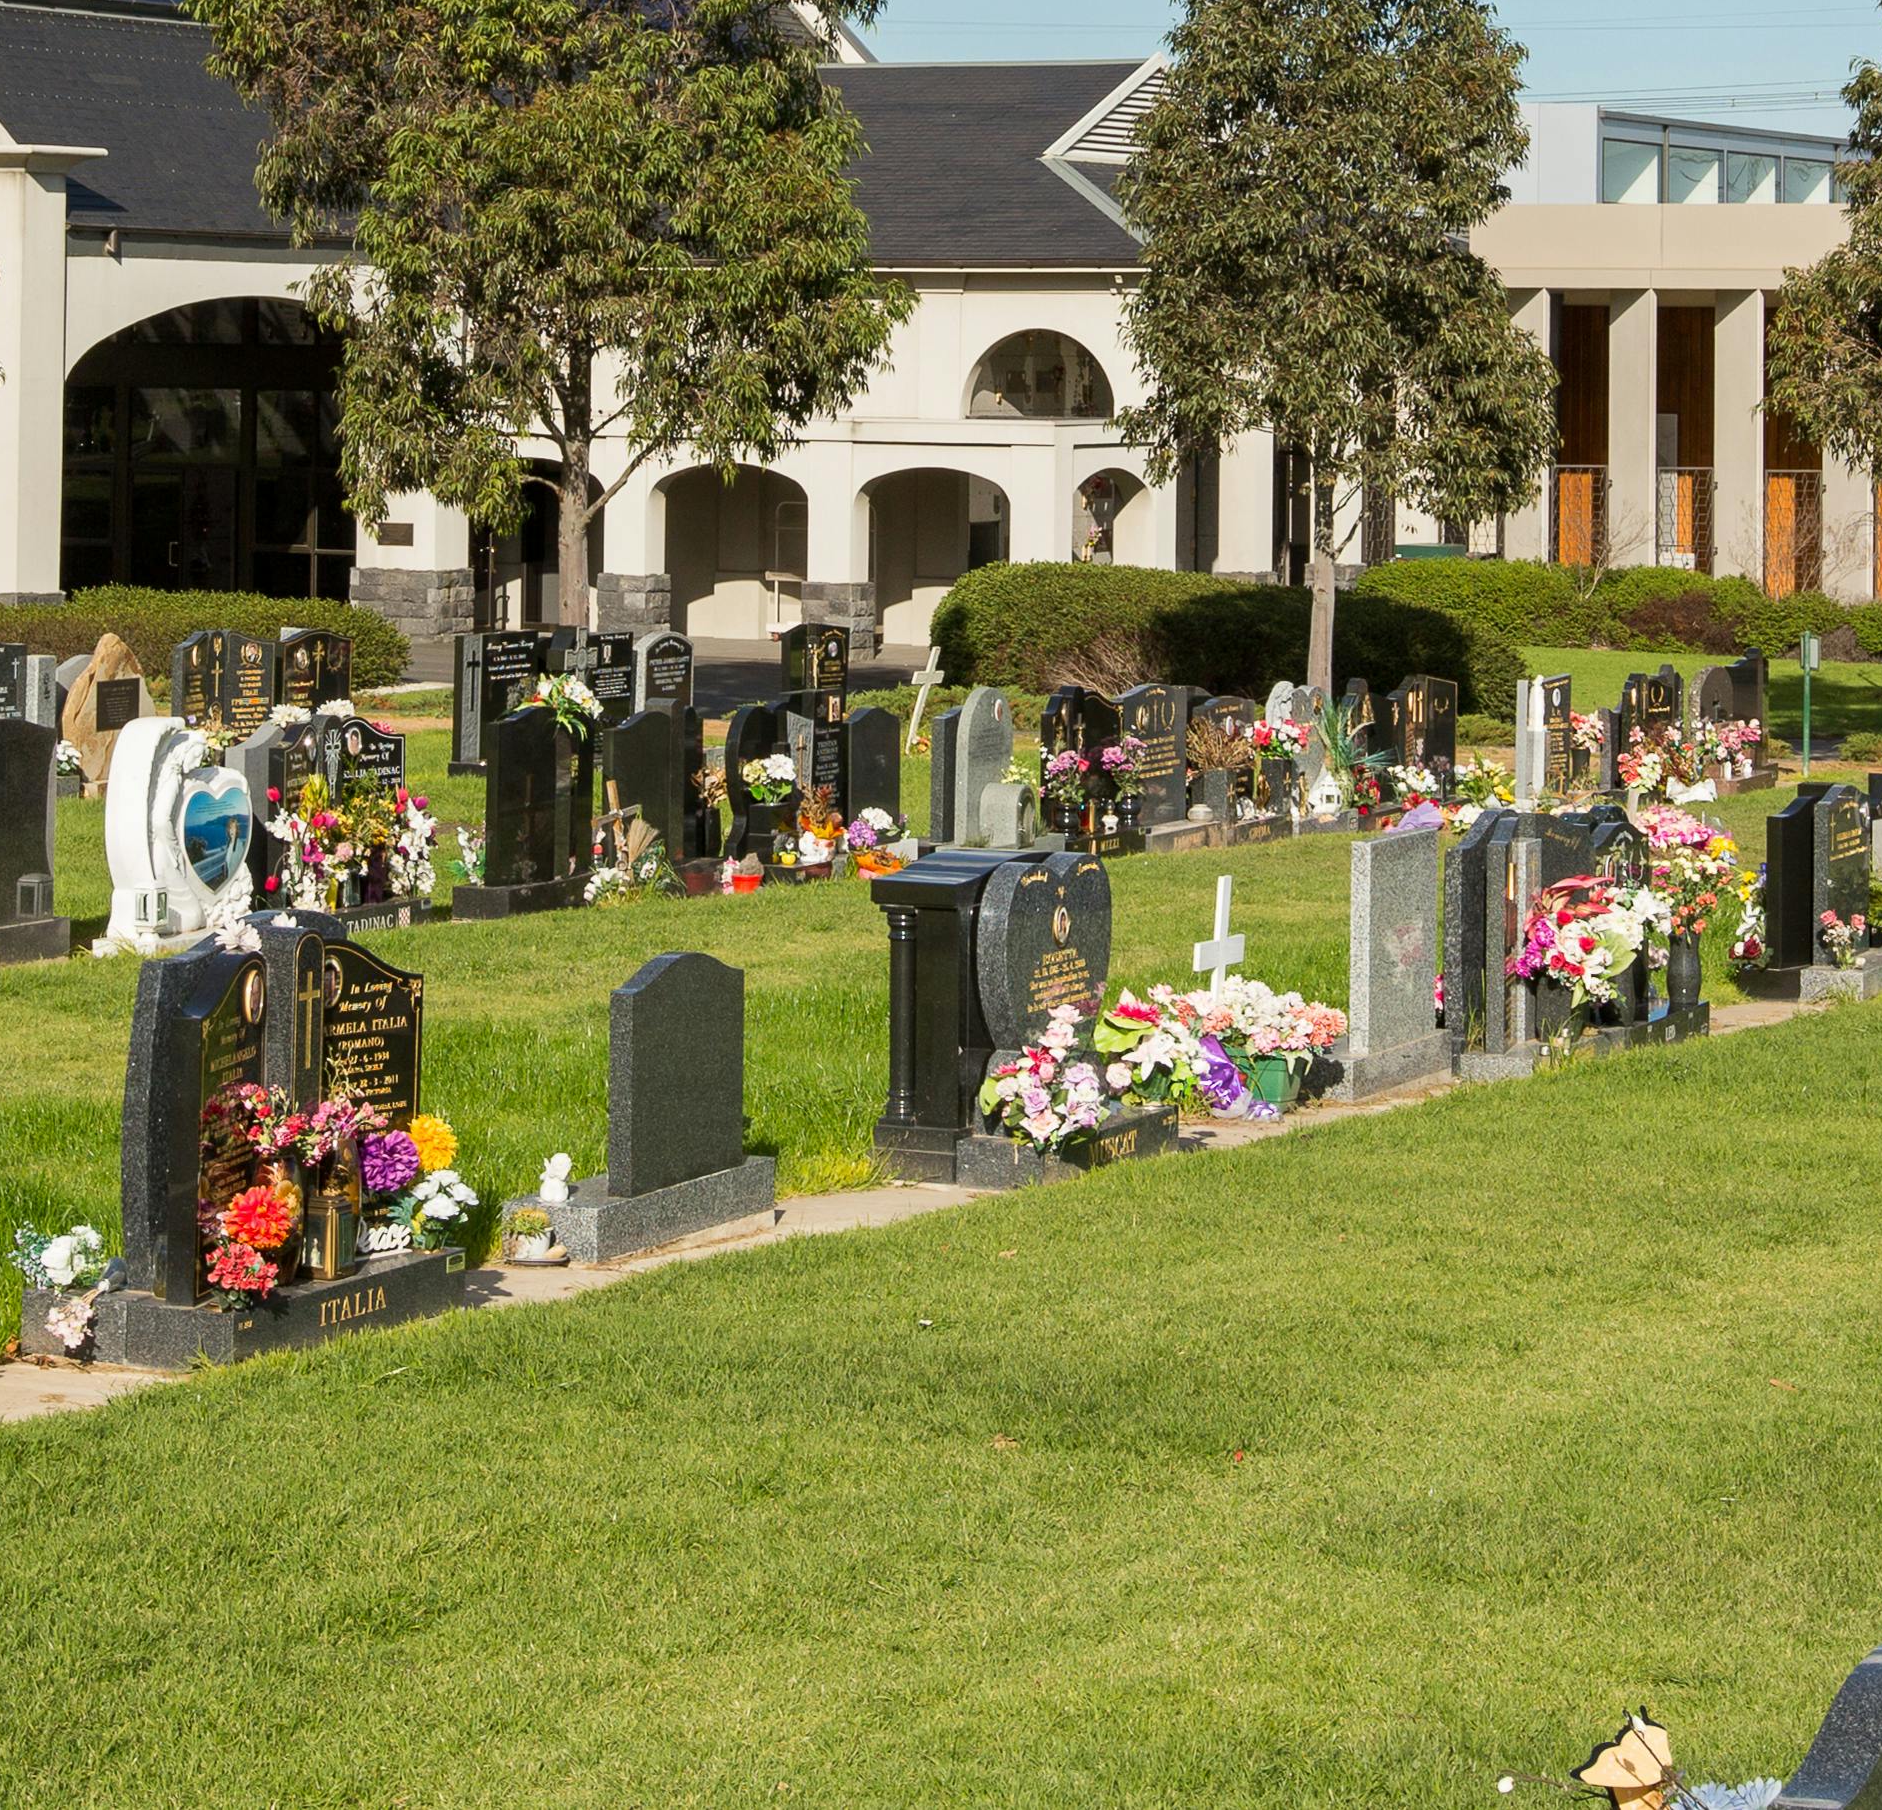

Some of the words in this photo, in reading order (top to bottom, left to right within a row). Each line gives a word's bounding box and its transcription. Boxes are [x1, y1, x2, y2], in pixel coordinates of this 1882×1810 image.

[347, 914, 394, 934] TADINAC
[350, 984, 360, 995] In
[364, 981, 393, 994] Loving
[339, 1001, 371, 1013] Memory
[375, 995, 388, 1012] Of
[323, 1021, 367, 1037] ARMELA
[372, 1015, 407, 1031] ITALIA
[338, 1036, 385, 1051] (ROMANO)
[210, 1044, 257, 1072] MICHELANGELO
[222, 1066, 244, 1082] ITALIA
[383, 1073, 399, 1085] 2011
[319, 1285, 387, 1327] ITALIA
